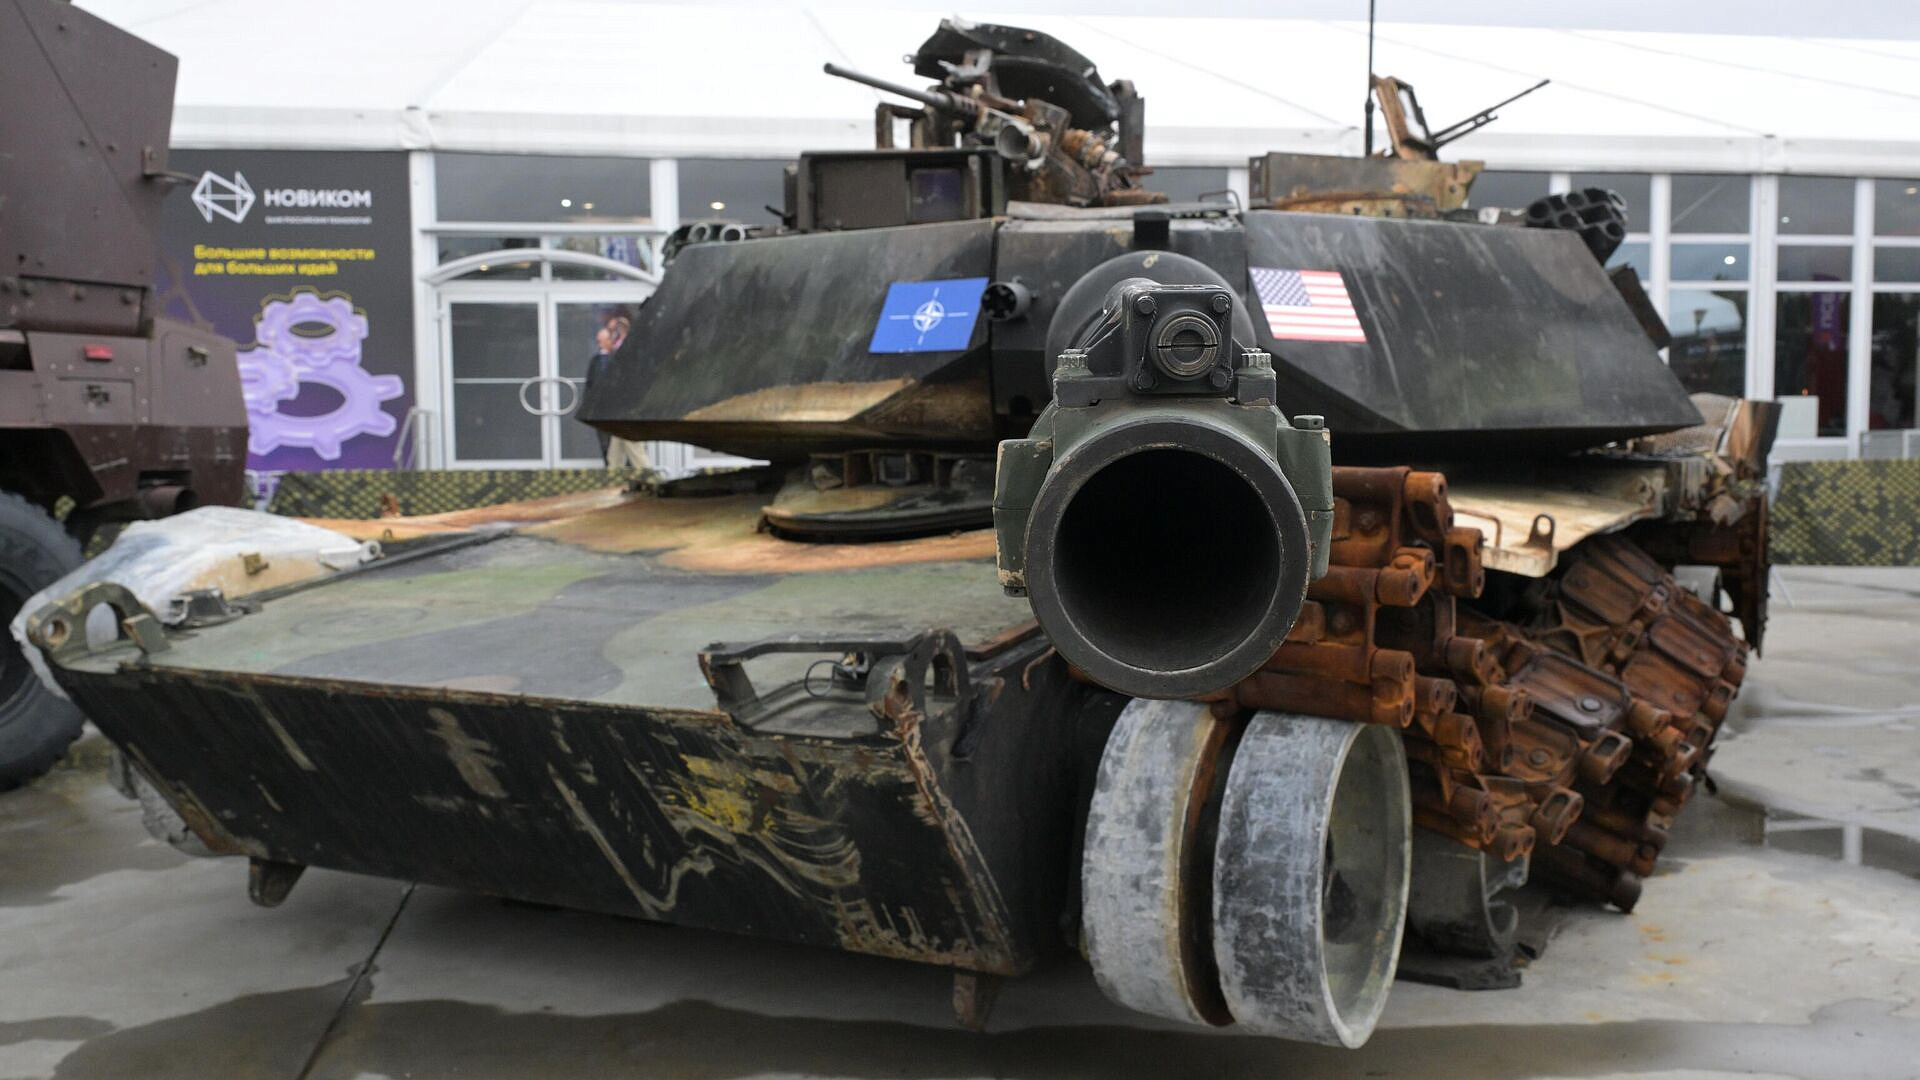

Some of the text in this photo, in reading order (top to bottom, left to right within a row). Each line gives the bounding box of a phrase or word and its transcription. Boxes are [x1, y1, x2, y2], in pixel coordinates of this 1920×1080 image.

[264, 189, 372, 207] НОВИКОМ
[194, 245, 376, 260] Большие возможности
[194, 260, 338, 275] для больших идей
